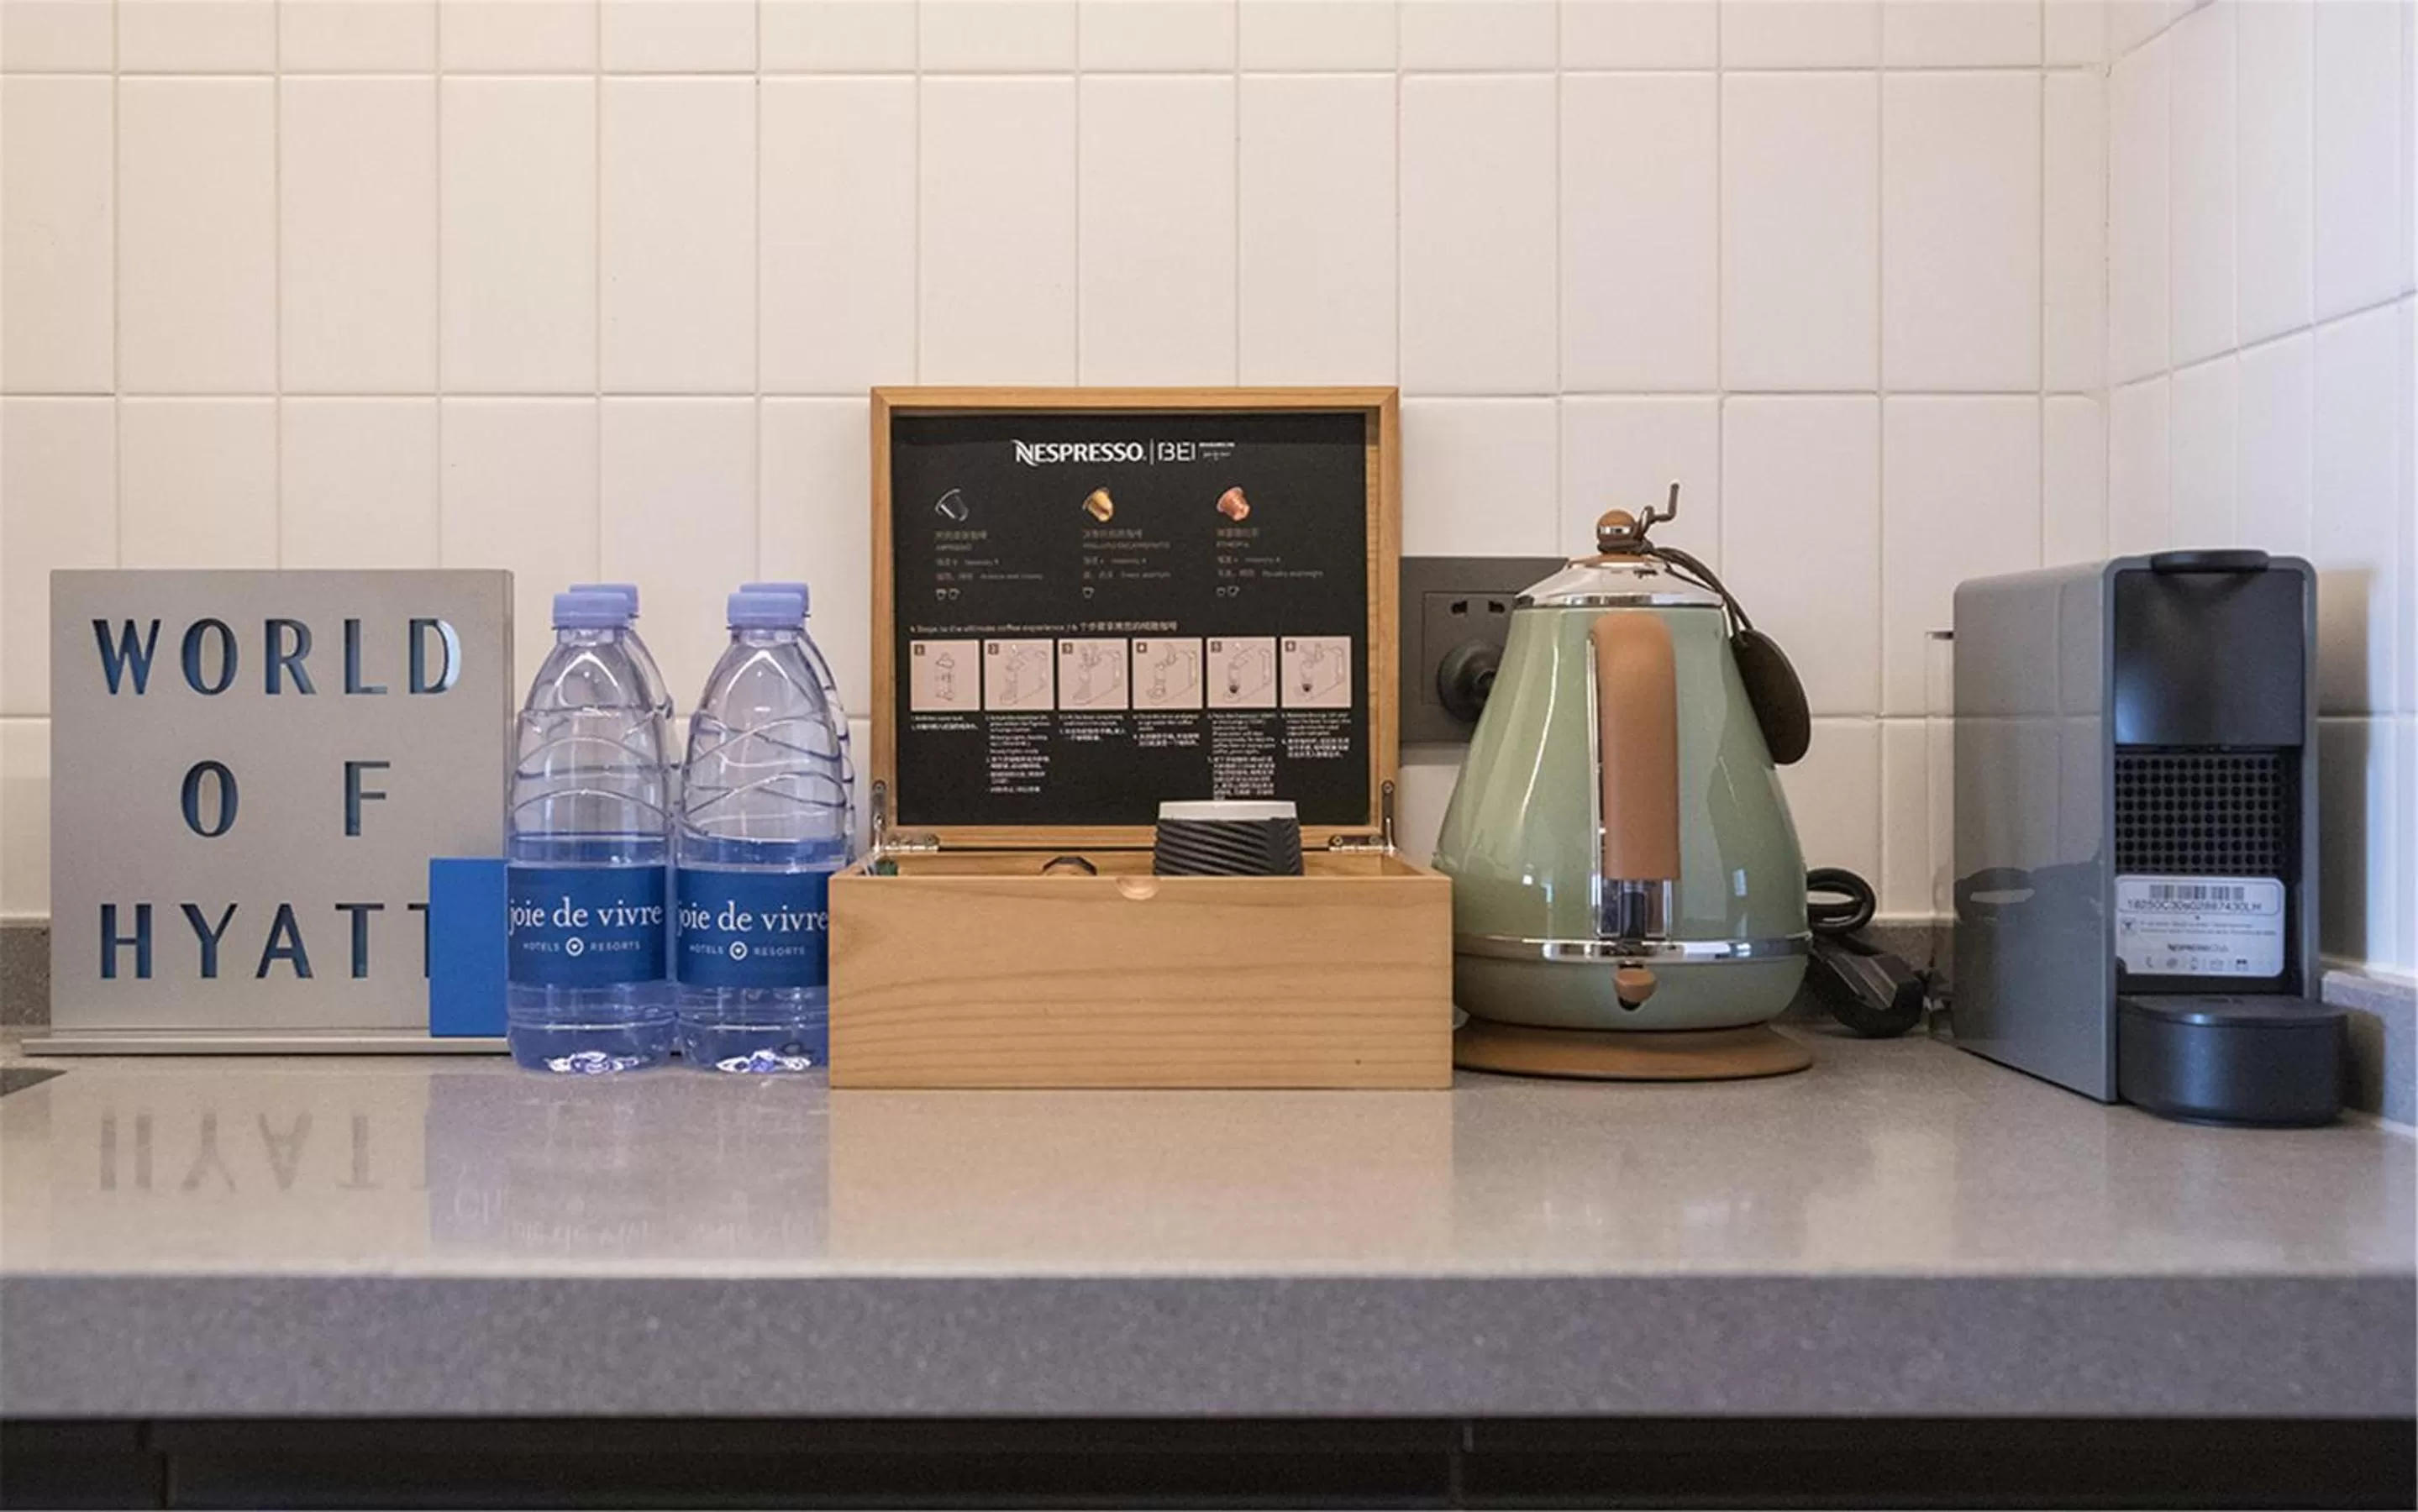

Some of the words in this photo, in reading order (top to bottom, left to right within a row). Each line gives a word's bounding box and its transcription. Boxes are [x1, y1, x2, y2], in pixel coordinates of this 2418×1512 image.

[1012, 439, 1143, 466] NESPRESSO
[92, 618, 462, 696] WORLD
[181, 760, 391, 837] OF
[508, 898, 545, 937] joie
[552, 895, 588, 928] de
[597, 899, 664, 927] vivre
[718, 900, 753, 932] de
[760, 905, 828, 932] vivre
[523, 942, 560, 952] HOTELS
[590, 941, 640, 952] RESORTS
[689, 944, 724, 955] HOTELS
[754, 947, 805, 957] RESORTS
